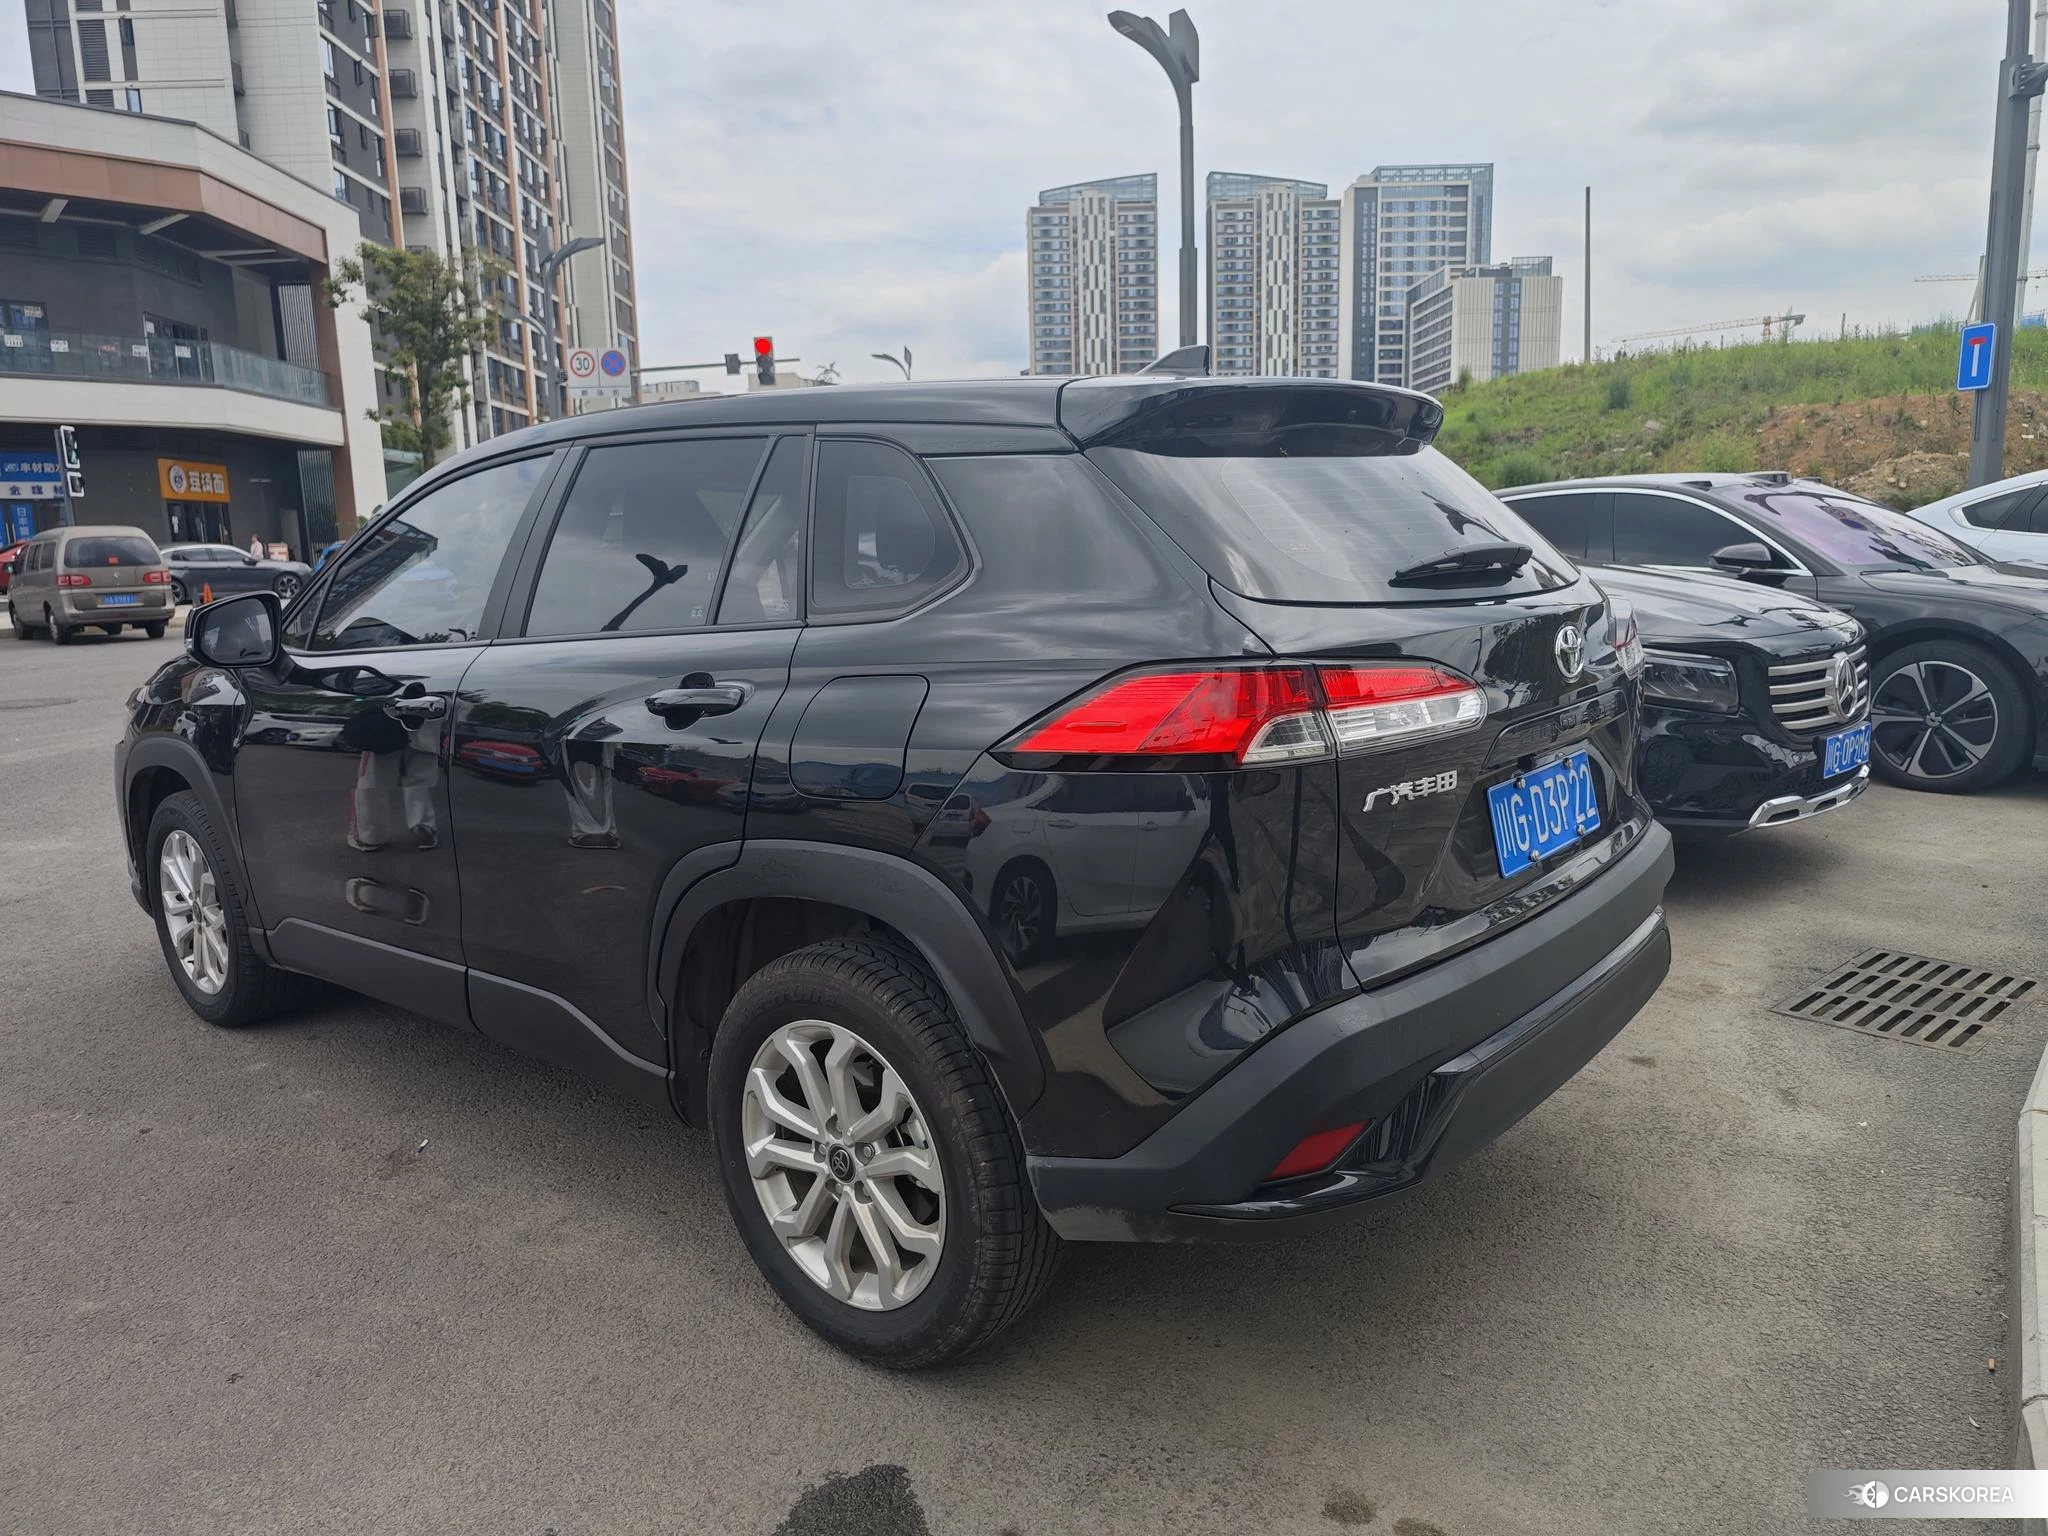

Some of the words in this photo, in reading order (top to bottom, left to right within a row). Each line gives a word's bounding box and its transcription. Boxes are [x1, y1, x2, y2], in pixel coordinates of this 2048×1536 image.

[575, 357, 590, 371] 30
[188, 471, 225, 494] 豆汤面
[1362, 769, 1458, 813] 广汽丰田
